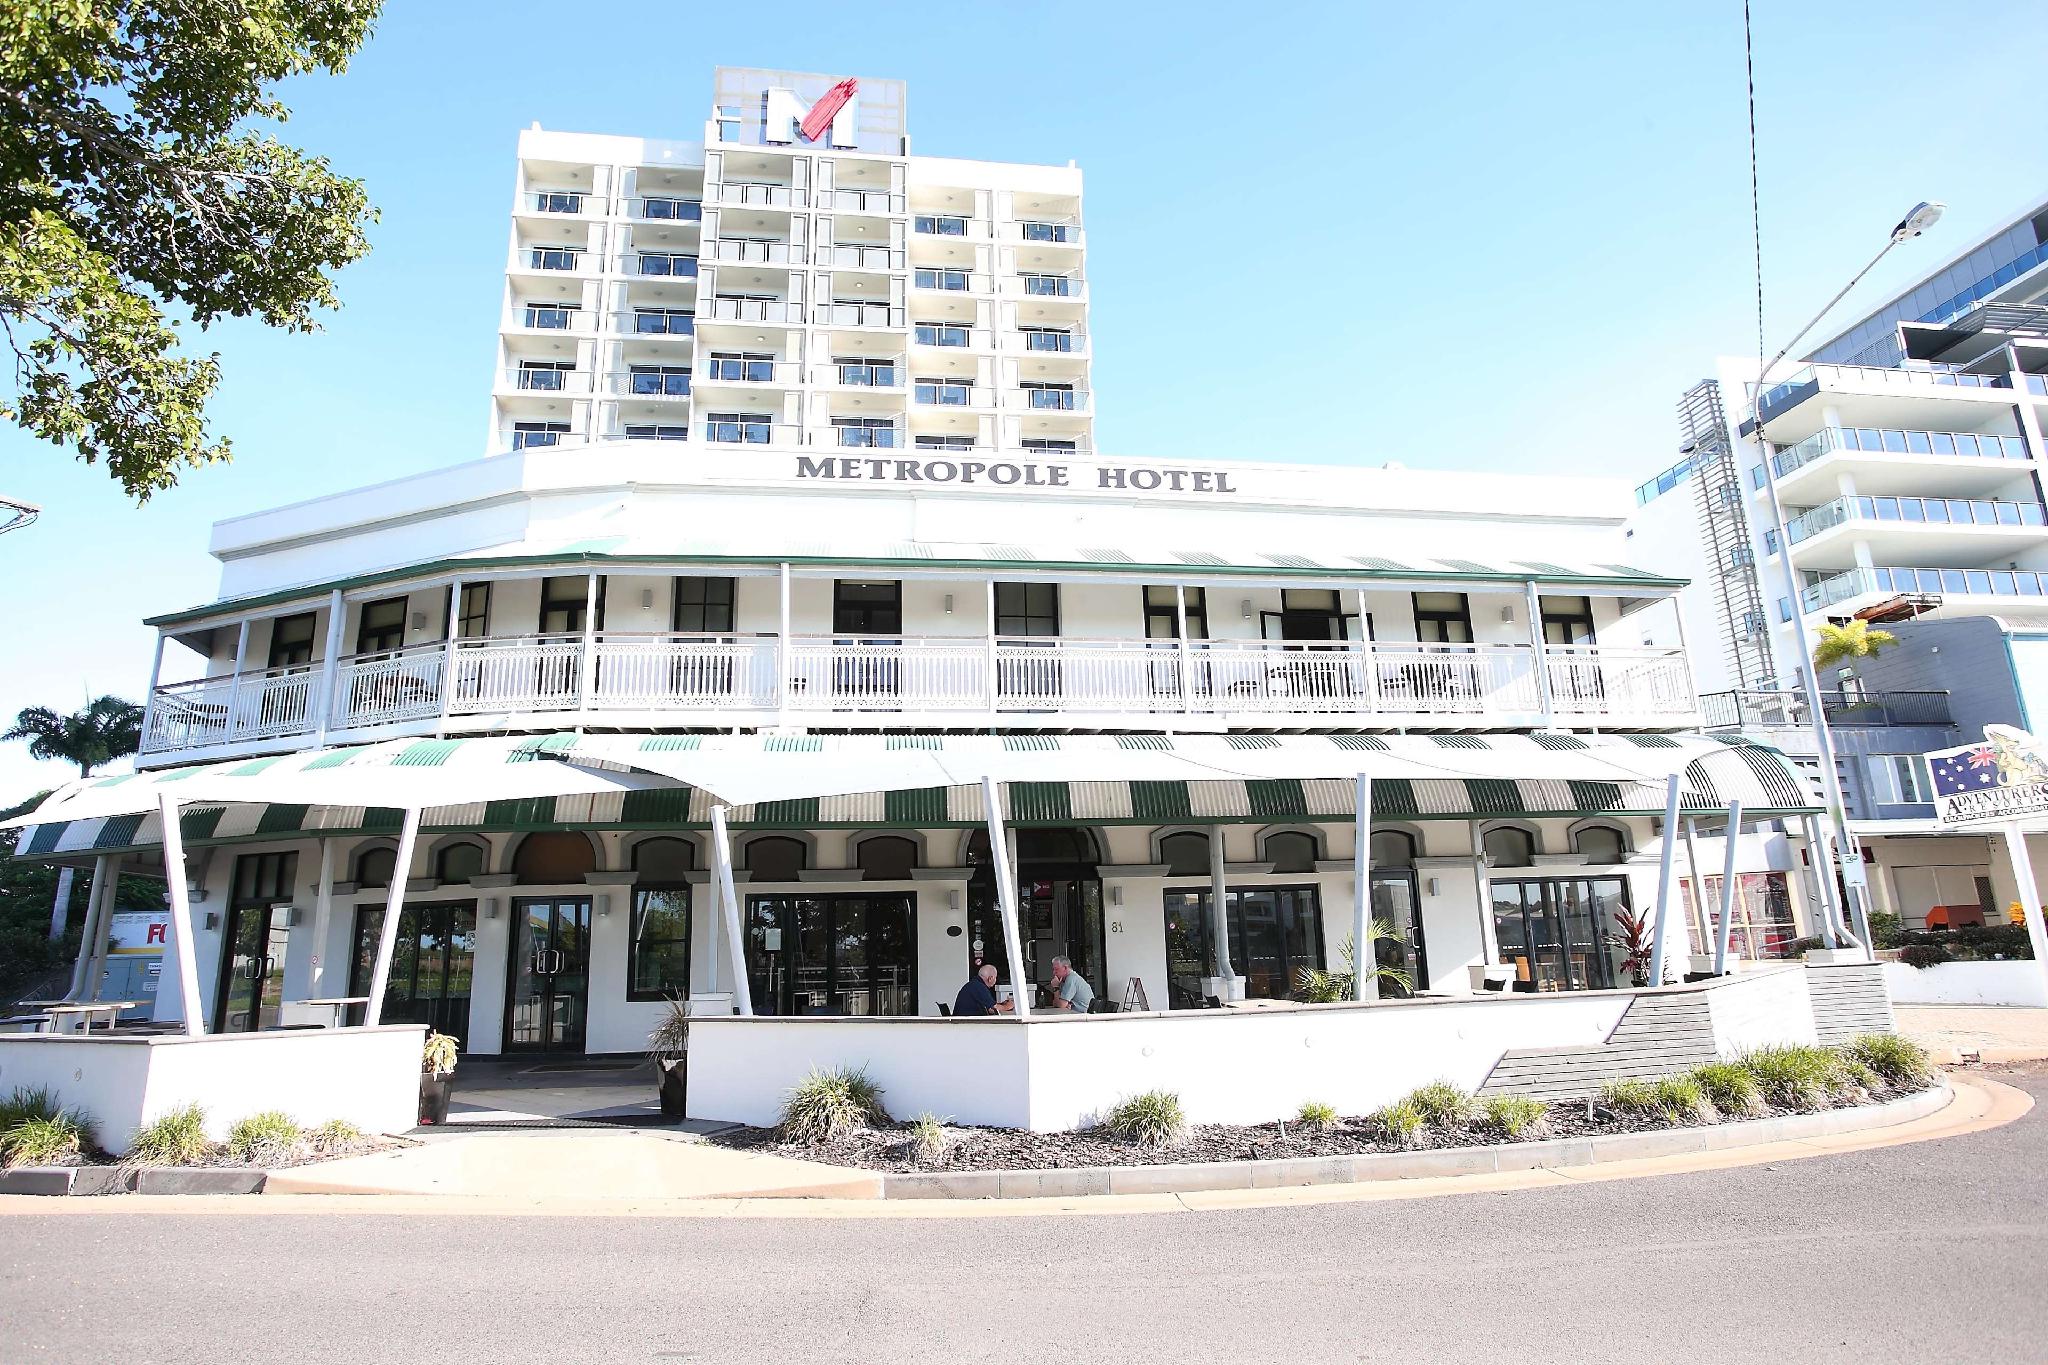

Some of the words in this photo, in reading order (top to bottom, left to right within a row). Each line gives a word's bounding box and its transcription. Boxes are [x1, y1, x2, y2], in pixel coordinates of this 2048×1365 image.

[795, 456, 1069, 487] METROPOLE
[1097, 467, 1237, 493] HOTEL
[1111, 921, 1124, 933] 81
